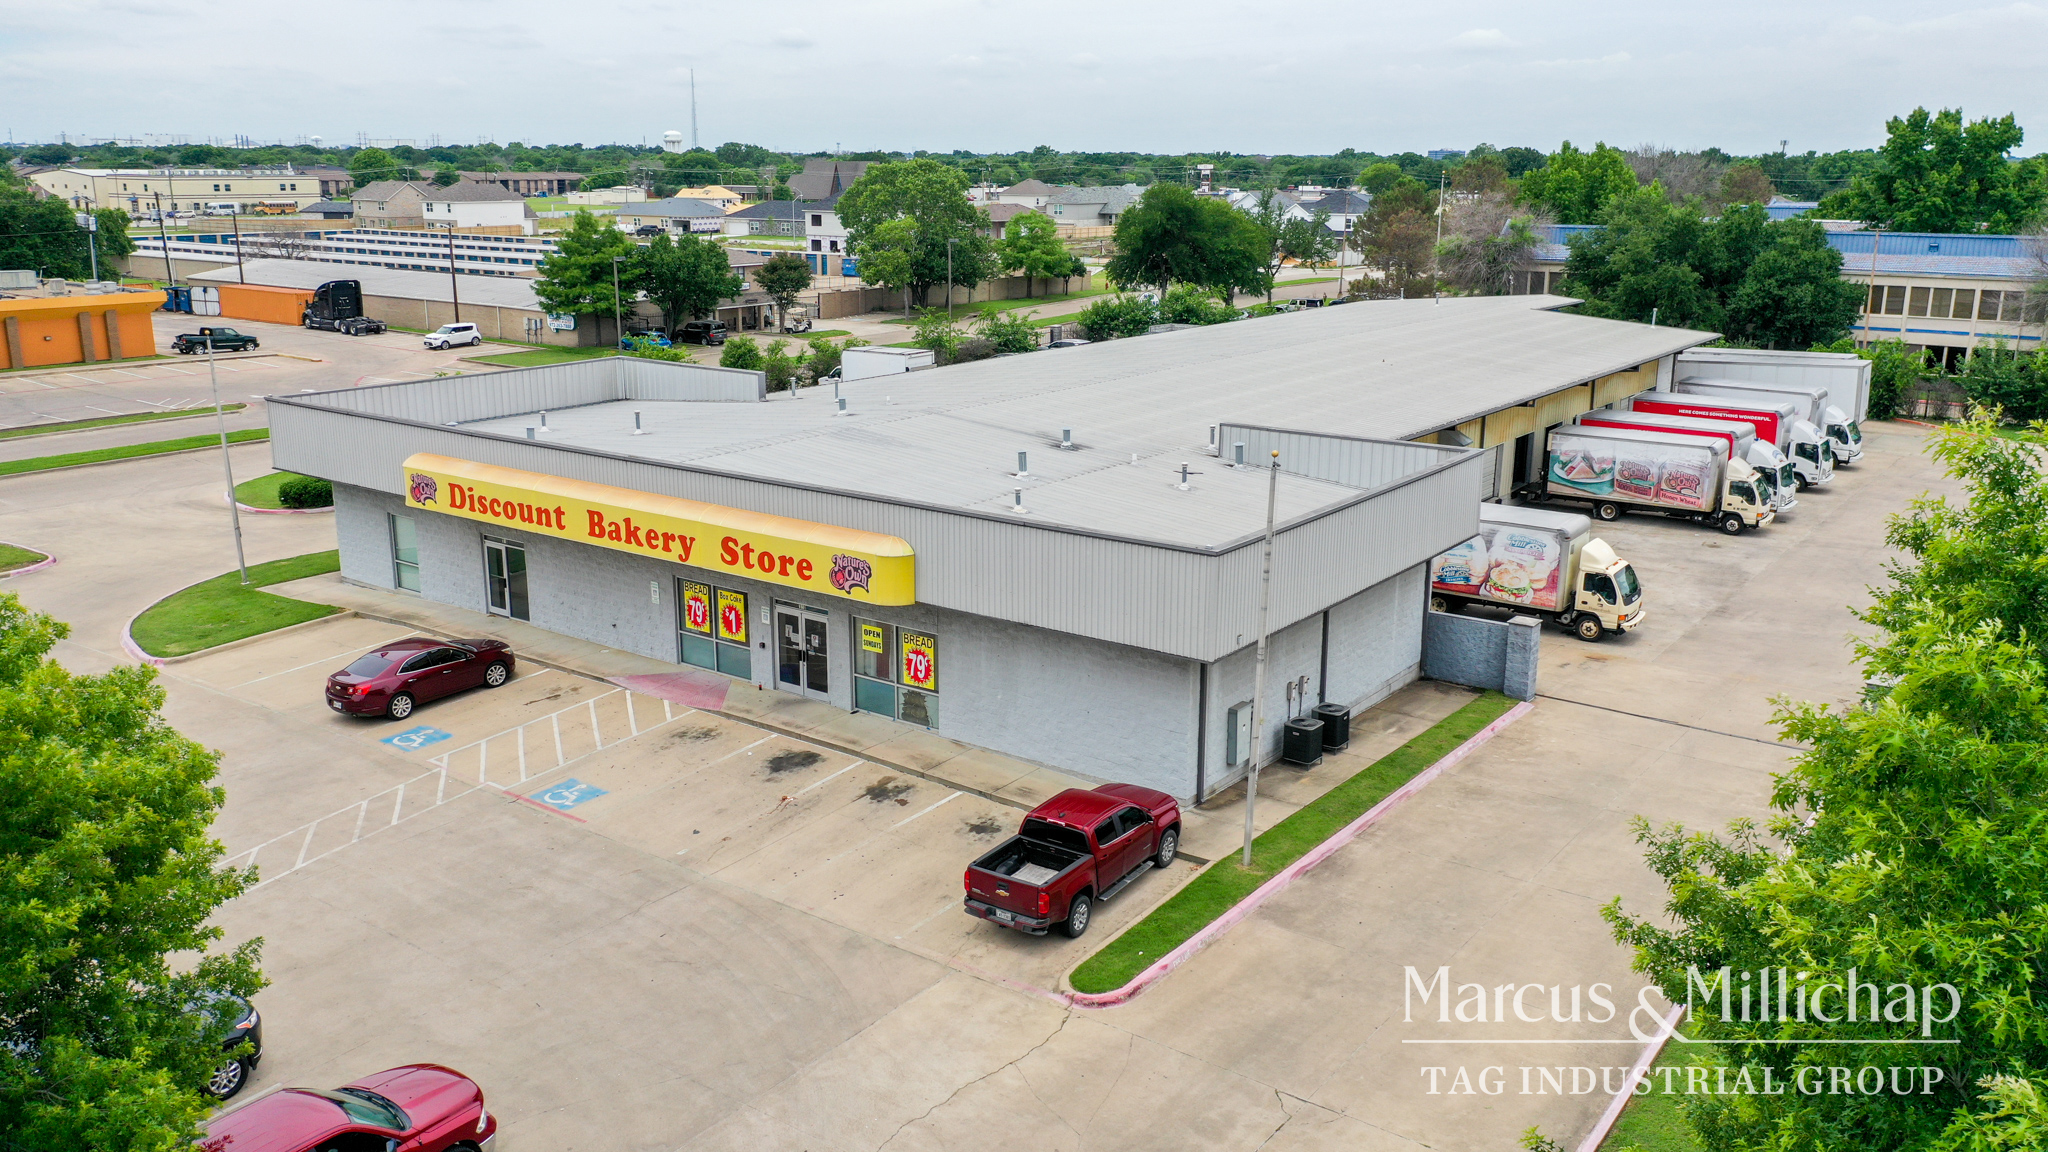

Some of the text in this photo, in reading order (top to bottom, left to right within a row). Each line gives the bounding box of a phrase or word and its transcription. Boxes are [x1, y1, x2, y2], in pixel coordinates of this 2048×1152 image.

[1709, 411, 1738, 419] SOMETHING
[1661, 492, 1697, 506] Honey Wheat
[448, 483, 813, 580] Discount Bakery Store
[1510, 540, 1527, 548] Mill
[832, 554, 870, 576] Nature's
[844, 566, 868, 588] Own
[685, 581, 708, 596] BREAD
[725, 608, 736, 633] $1
[864, 629, 881, 639] OPEN
[904, 633, 933, 649] BREAD
